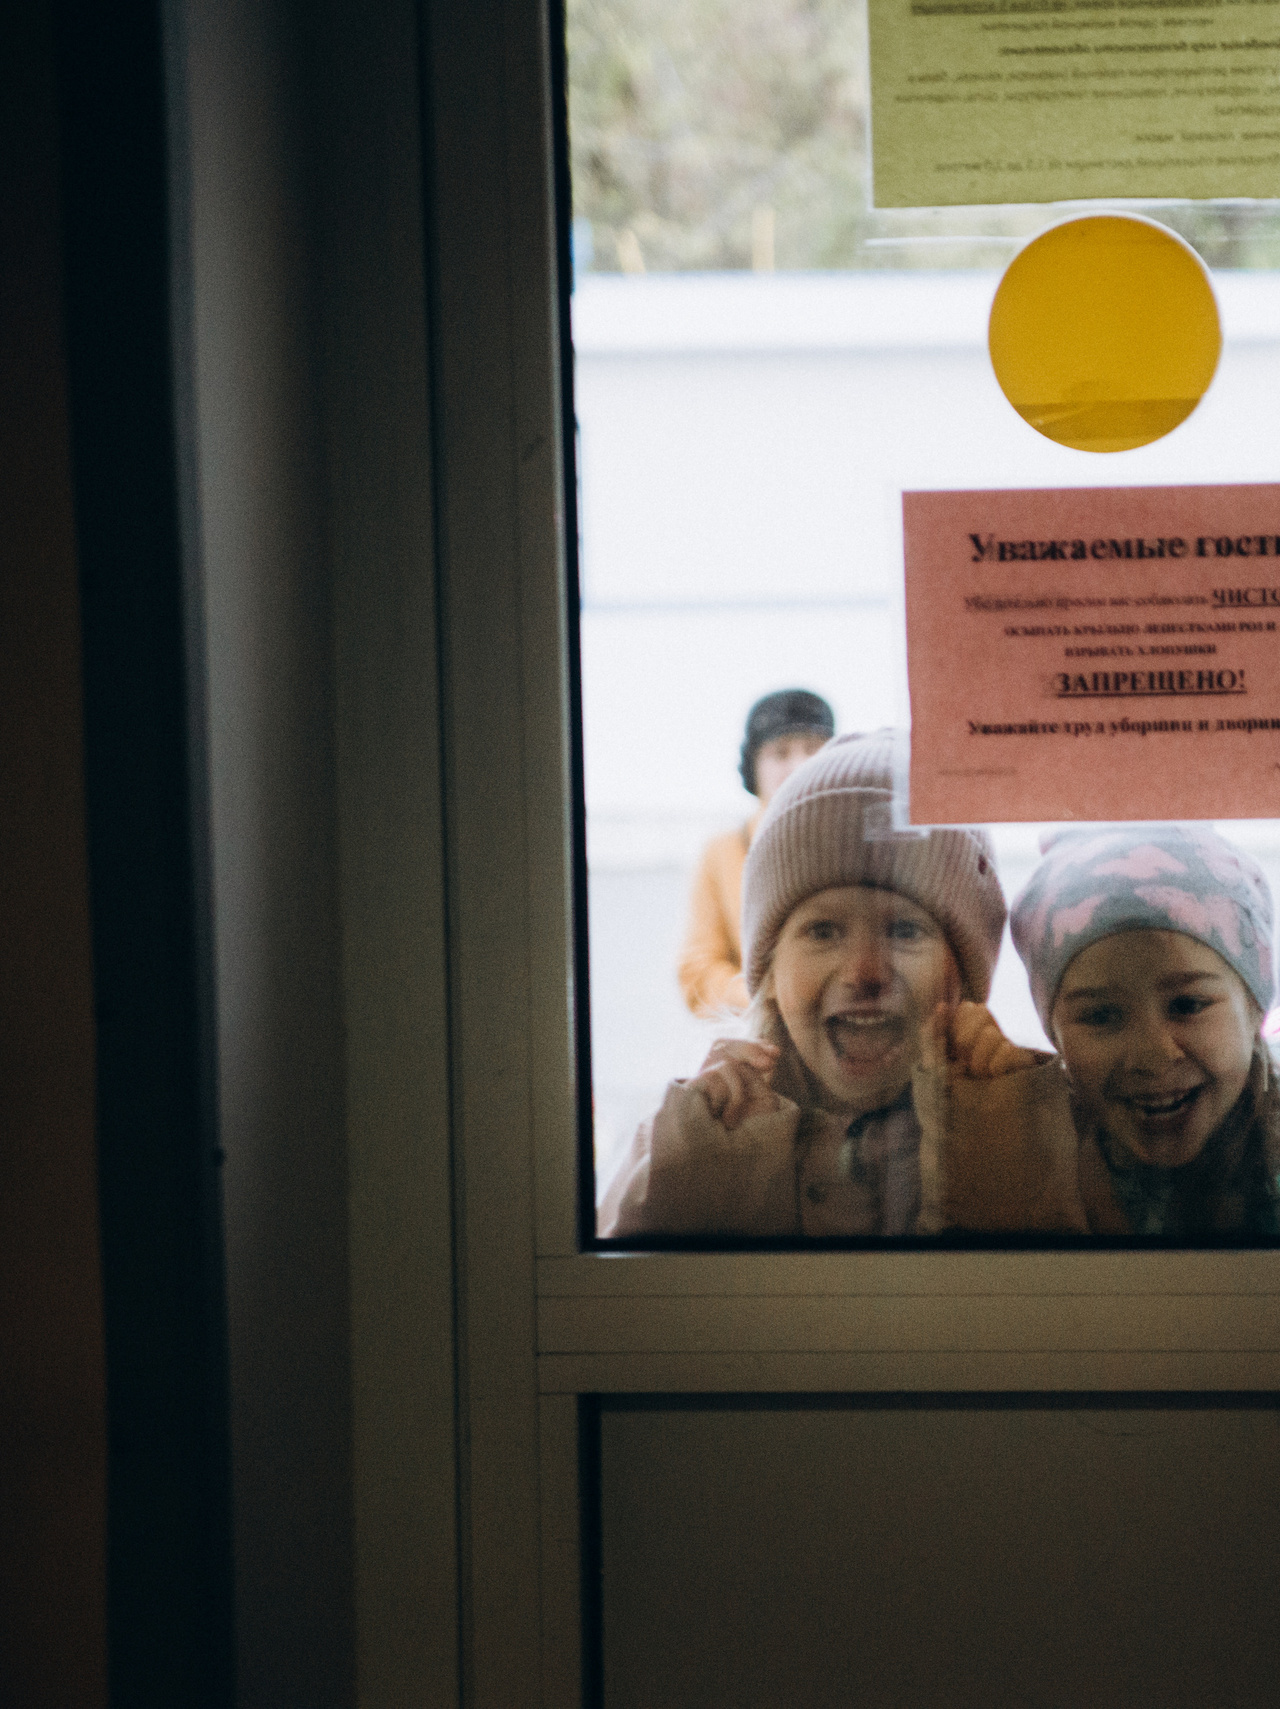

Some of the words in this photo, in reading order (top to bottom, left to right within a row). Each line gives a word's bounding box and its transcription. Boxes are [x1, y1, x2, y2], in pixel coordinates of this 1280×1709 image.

[967, 531, 1185, 564] Уважаемые
[1054, 669, 1246, 696] ЗАПРЕЩЕНО!
[966, 718, 1060, 736] Уважайте
[1062, 719, 1106, 738] труд
[1197, 719, 1210, 732] и
